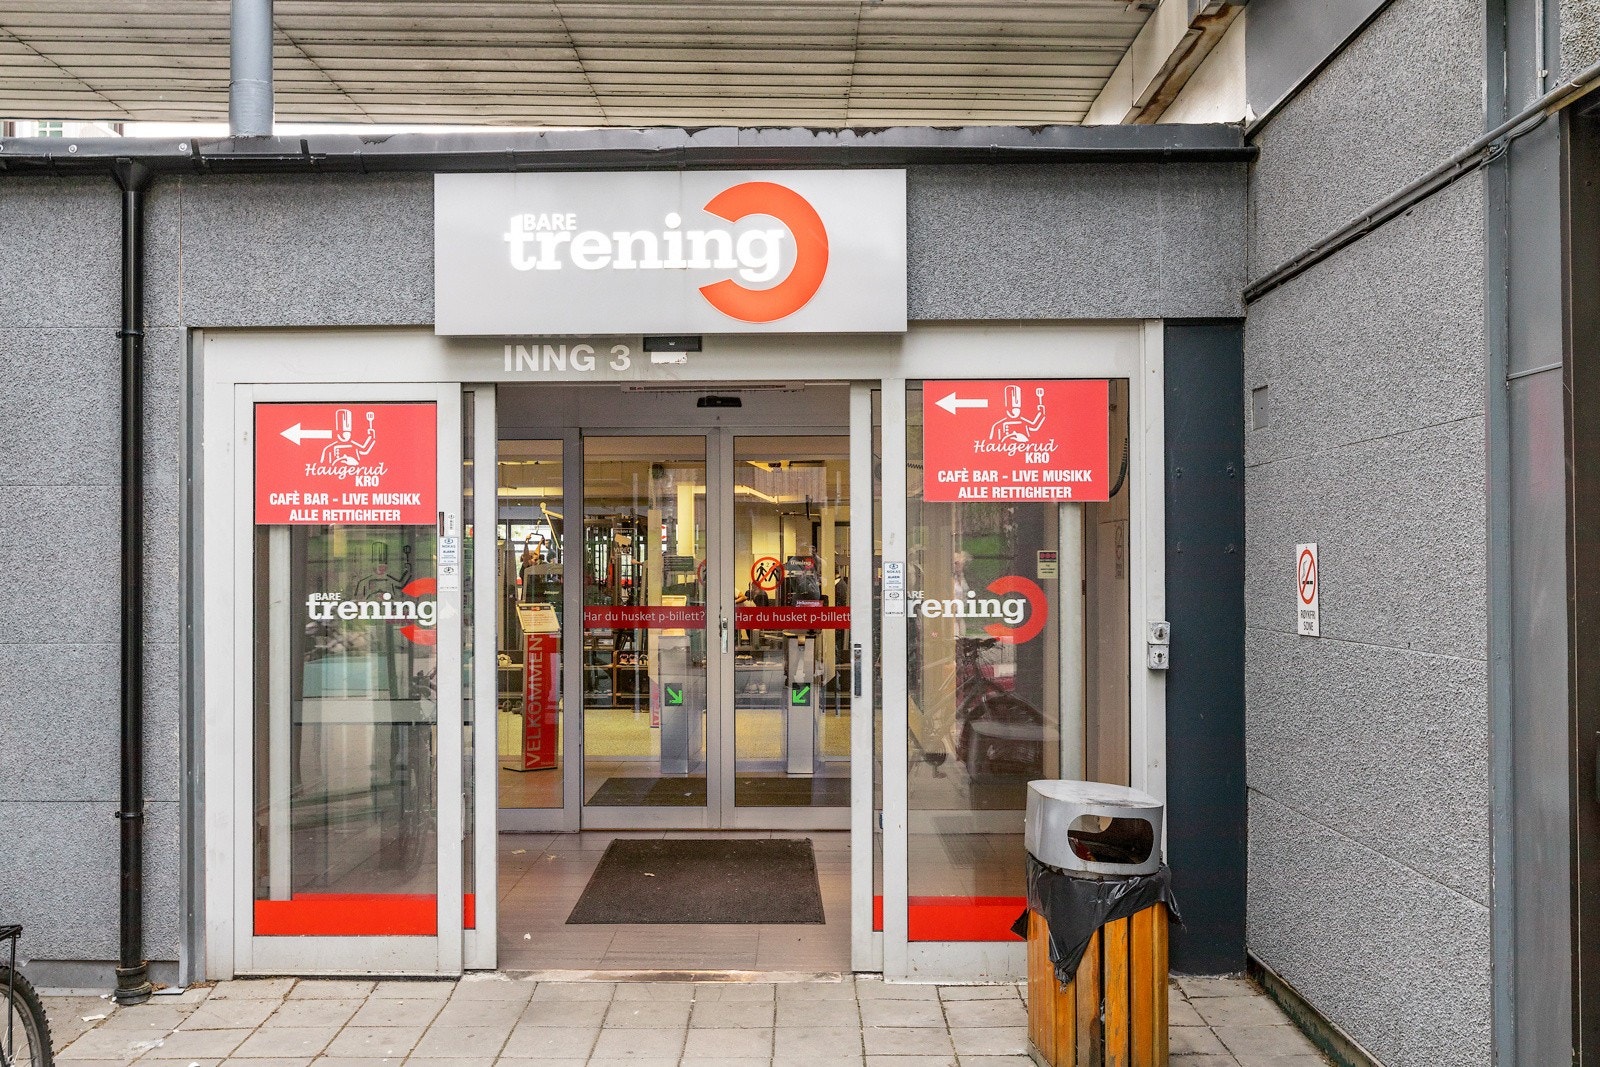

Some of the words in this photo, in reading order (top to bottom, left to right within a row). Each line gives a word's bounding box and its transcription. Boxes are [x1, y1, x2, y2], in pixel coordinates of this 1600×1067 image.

[523, 213, 577, 231] BARE
[503, 212, 785, 282] trening
[504, 344, 596, 372] INNG
[609, 344, 632, 372] 3
[973, 439, 1059, 457] Haugerud
[1025, 452, 1050, 464] KRO
[305, 462, 388, 480] Haugerud
[972, 471, 999, 483] BAR
[1012, 470, 1039, 483] LIVE
[1042, 470, 1092, 483] MUSIKK
[355, 475, 380, 487] KRO
[958, 486, 988, 499] ALLE
[992, 486, 1072, 499] RETTIGHETER
[303, 493, 329, 506] BAR
[342, 493, 368, 506] LIVE
[372, 493, 421, 506] MUSIKK
[289, 509, 319, 521] ALLE
[322, 509, 401, 521] RETTIGHETER
[314, 592, 341, 601] BARE
[305, 592, 437, 626] trening
[907, 590, 1026, 624] rening
[584, 611, 602, 621] Har
[605, 611, 618, 621] du
[621, 611, 656, 621] husket
[658, 611, 705, 623] p-billett?
[736, 612, 753, 622] Har
[756, 611, 770, 622] du
[772, 611, 807, 622] husket
[1303, 621, 1314, 631] SONE
[526, 636, 543, 767] VELKOMMEN
